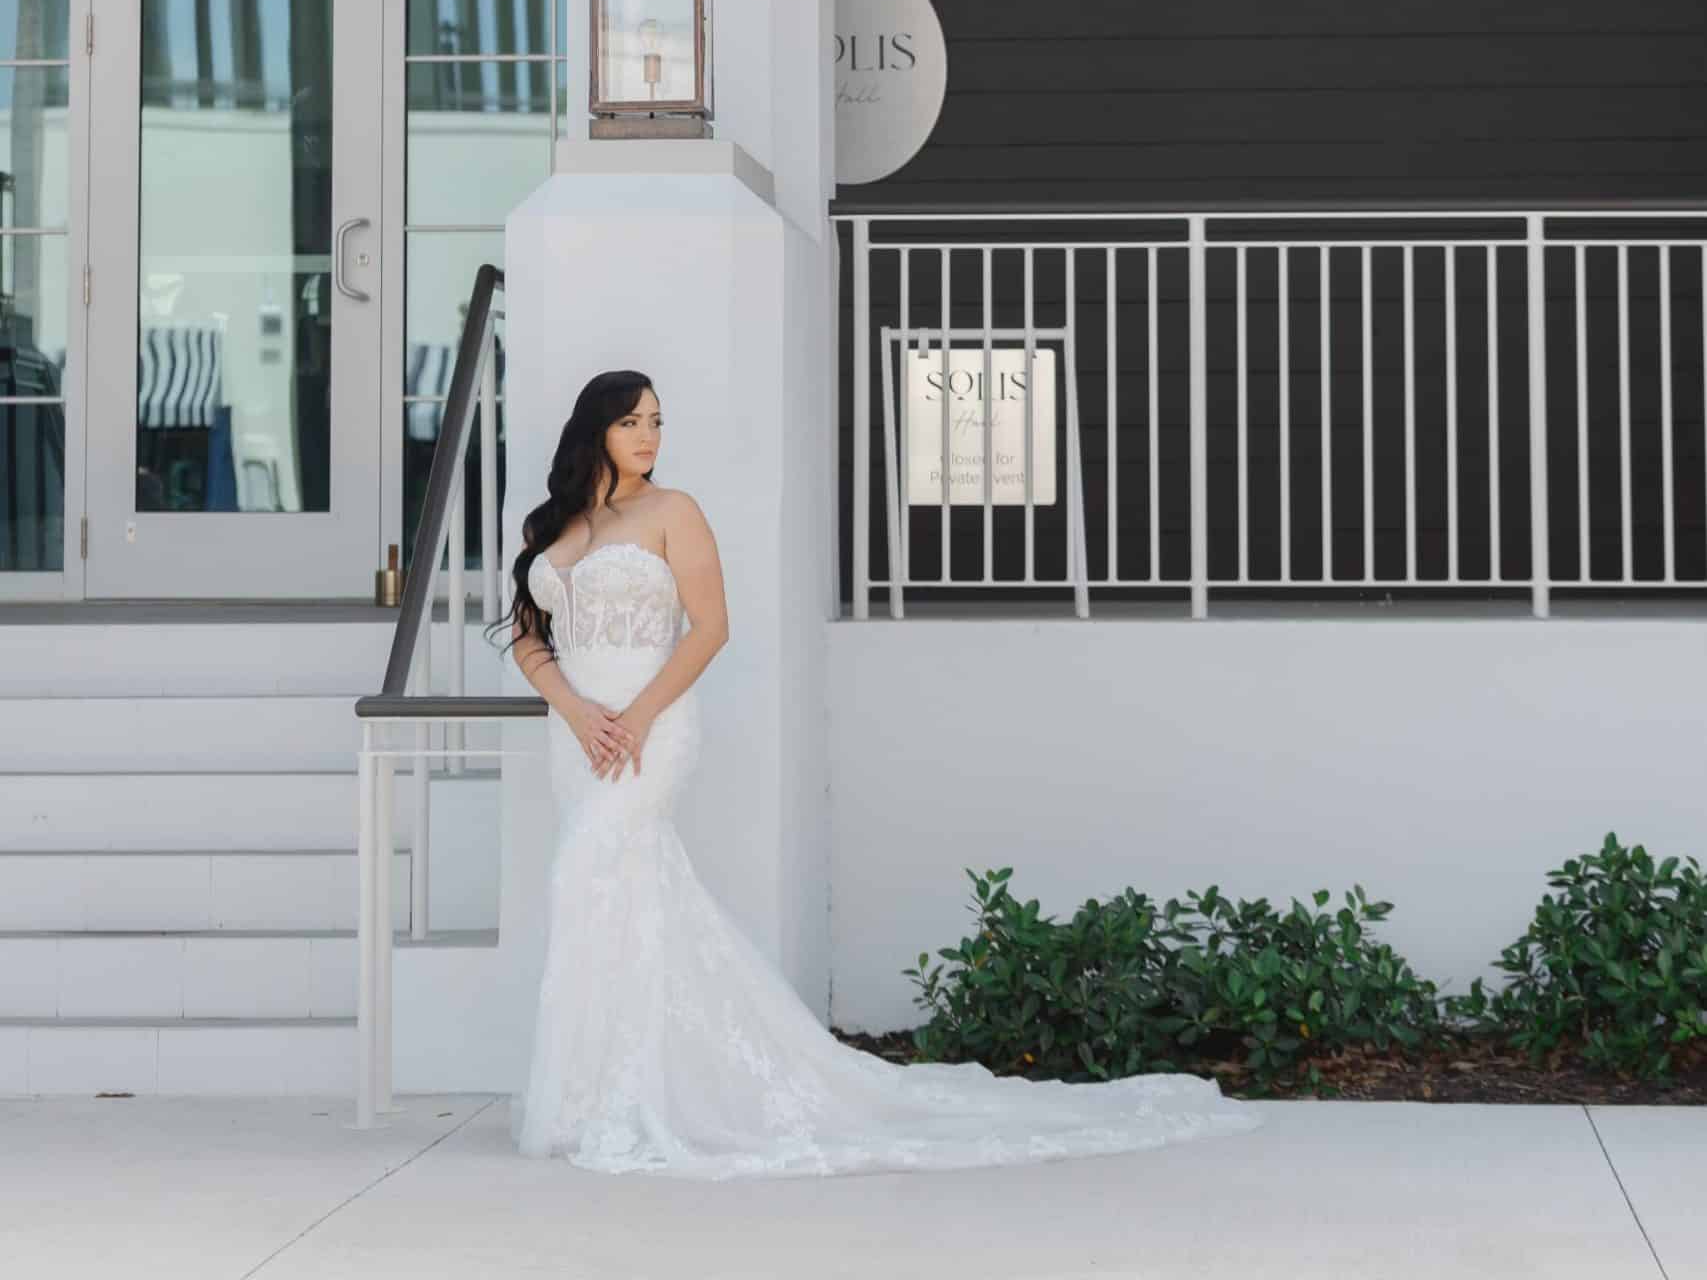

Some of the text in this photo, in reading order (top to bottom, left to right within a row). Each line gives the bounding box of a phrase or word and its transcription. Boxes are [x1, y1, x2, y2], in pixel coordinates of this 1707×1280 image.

[925, 369, 1029, 401] SOLIS
[952, 409, 1001, 438] Hal
[940, 451, 1016, 465] lose for
[930, 471, 1027, 485] Pvate vent
